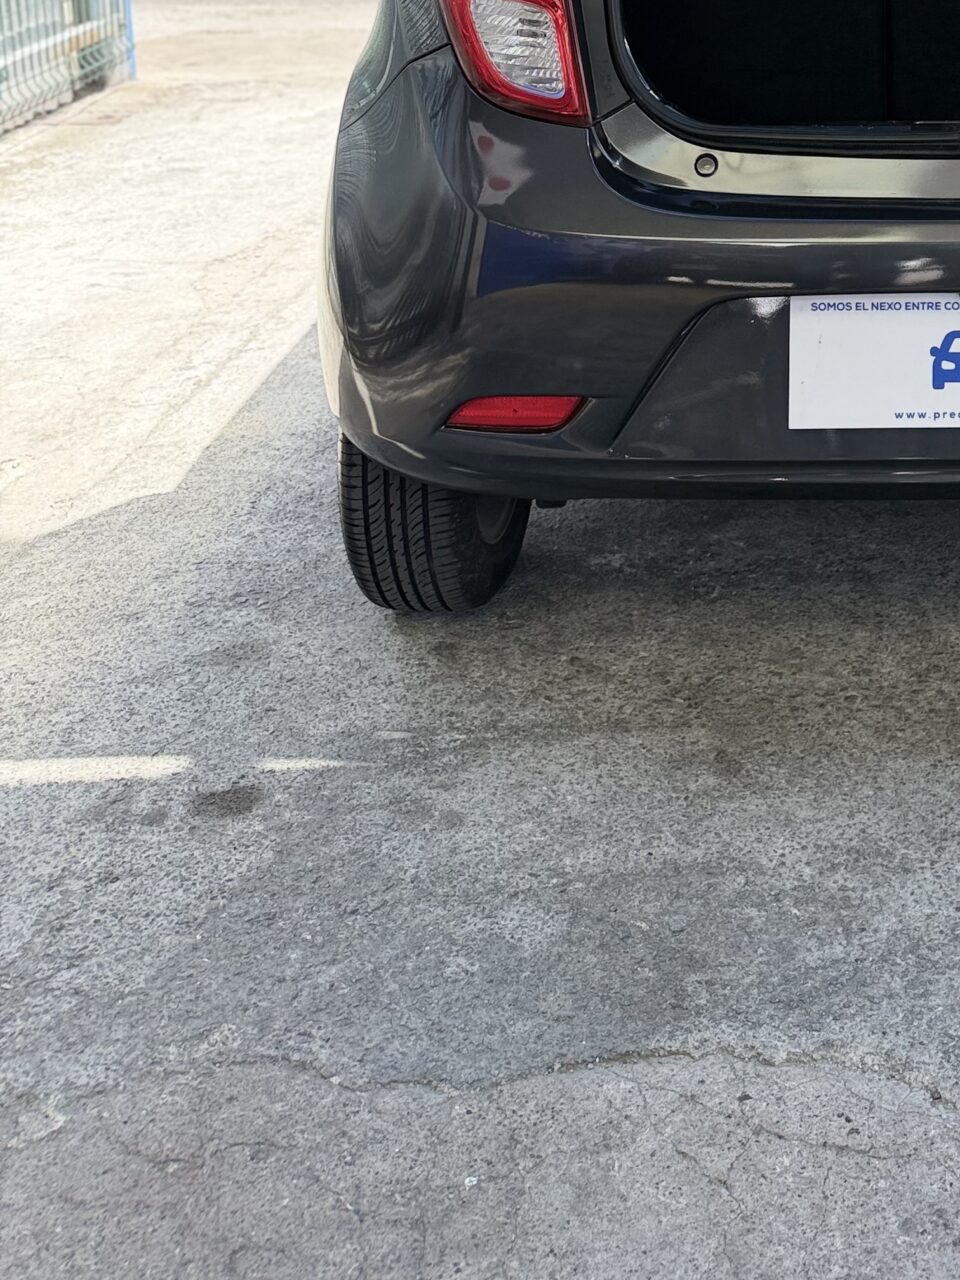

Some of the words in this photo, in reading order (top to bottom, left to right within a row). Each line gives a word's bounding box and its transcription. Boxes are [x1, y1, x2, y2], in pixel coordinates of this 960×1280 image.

[810, 301, 853, 312] SOMOS
[854, 301, 869, 312] EL
[870, 301, 902, 312] NEXO
[904, 301, 942, 312] ENTRE
